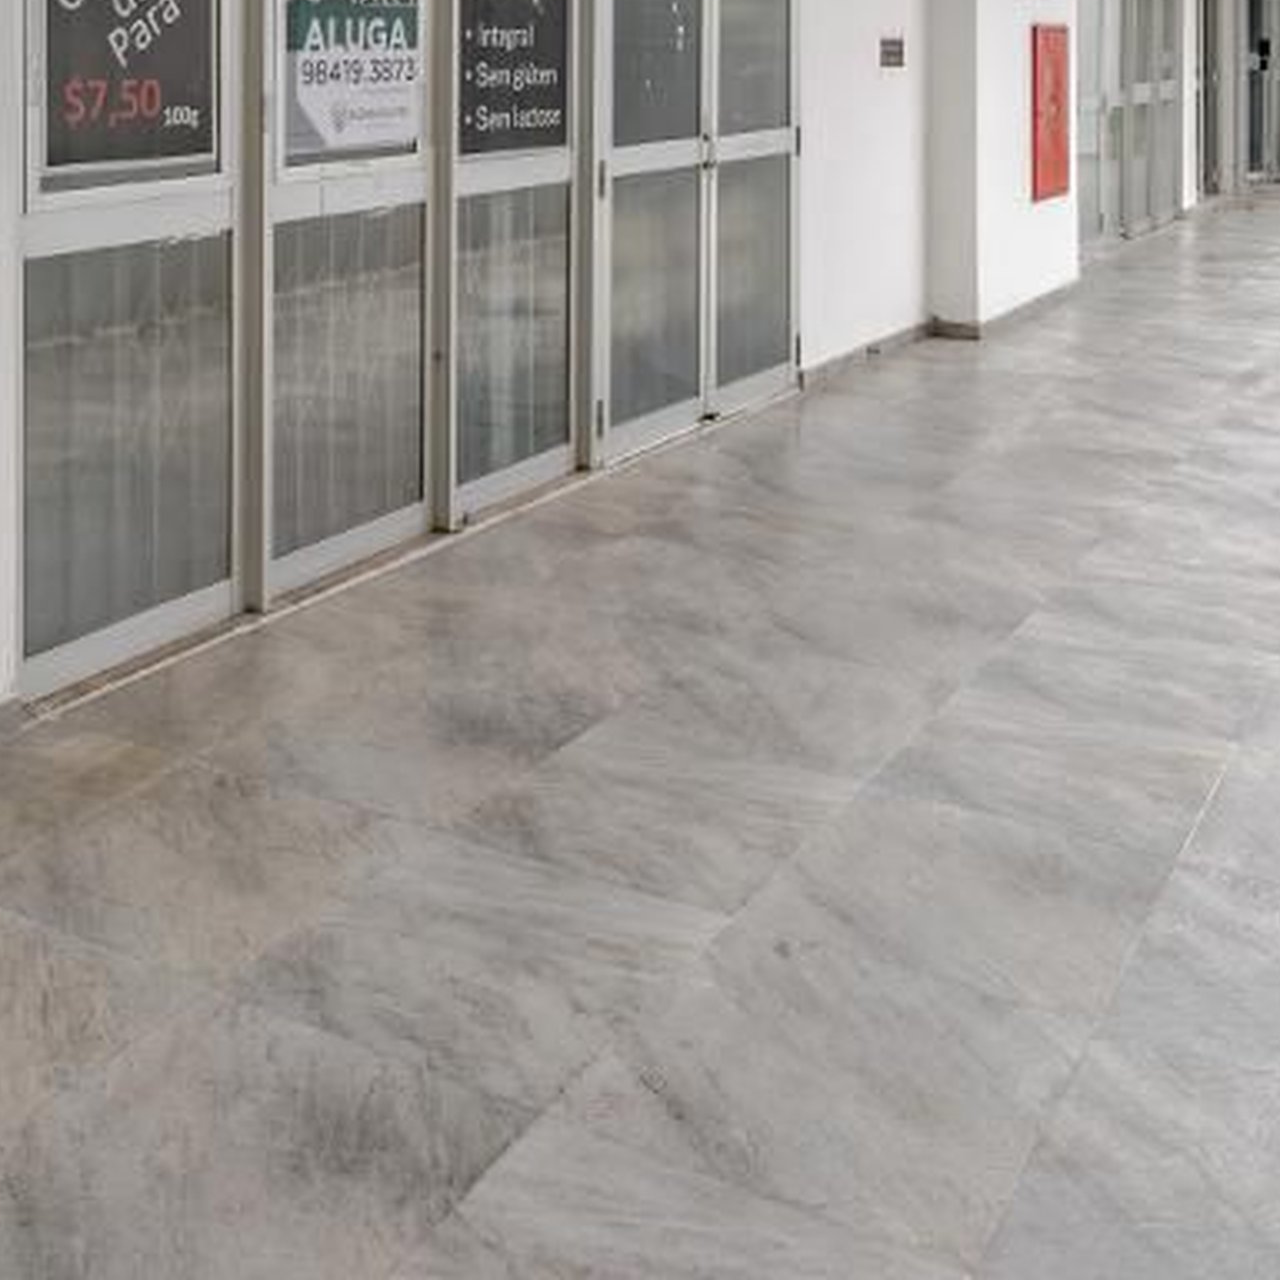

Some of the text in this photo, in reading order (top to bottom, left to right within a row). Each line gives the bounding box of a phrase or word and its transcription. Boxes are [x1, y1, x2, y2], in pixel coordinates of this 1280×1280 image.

[303, 18, 410, 52] ALUGA
[477, 25, 535, 51] Integral
[476, 61, 511, 87] Sem
[63, 77, 161, 128] $7,50
[476, 105, 511, 131] Sem
